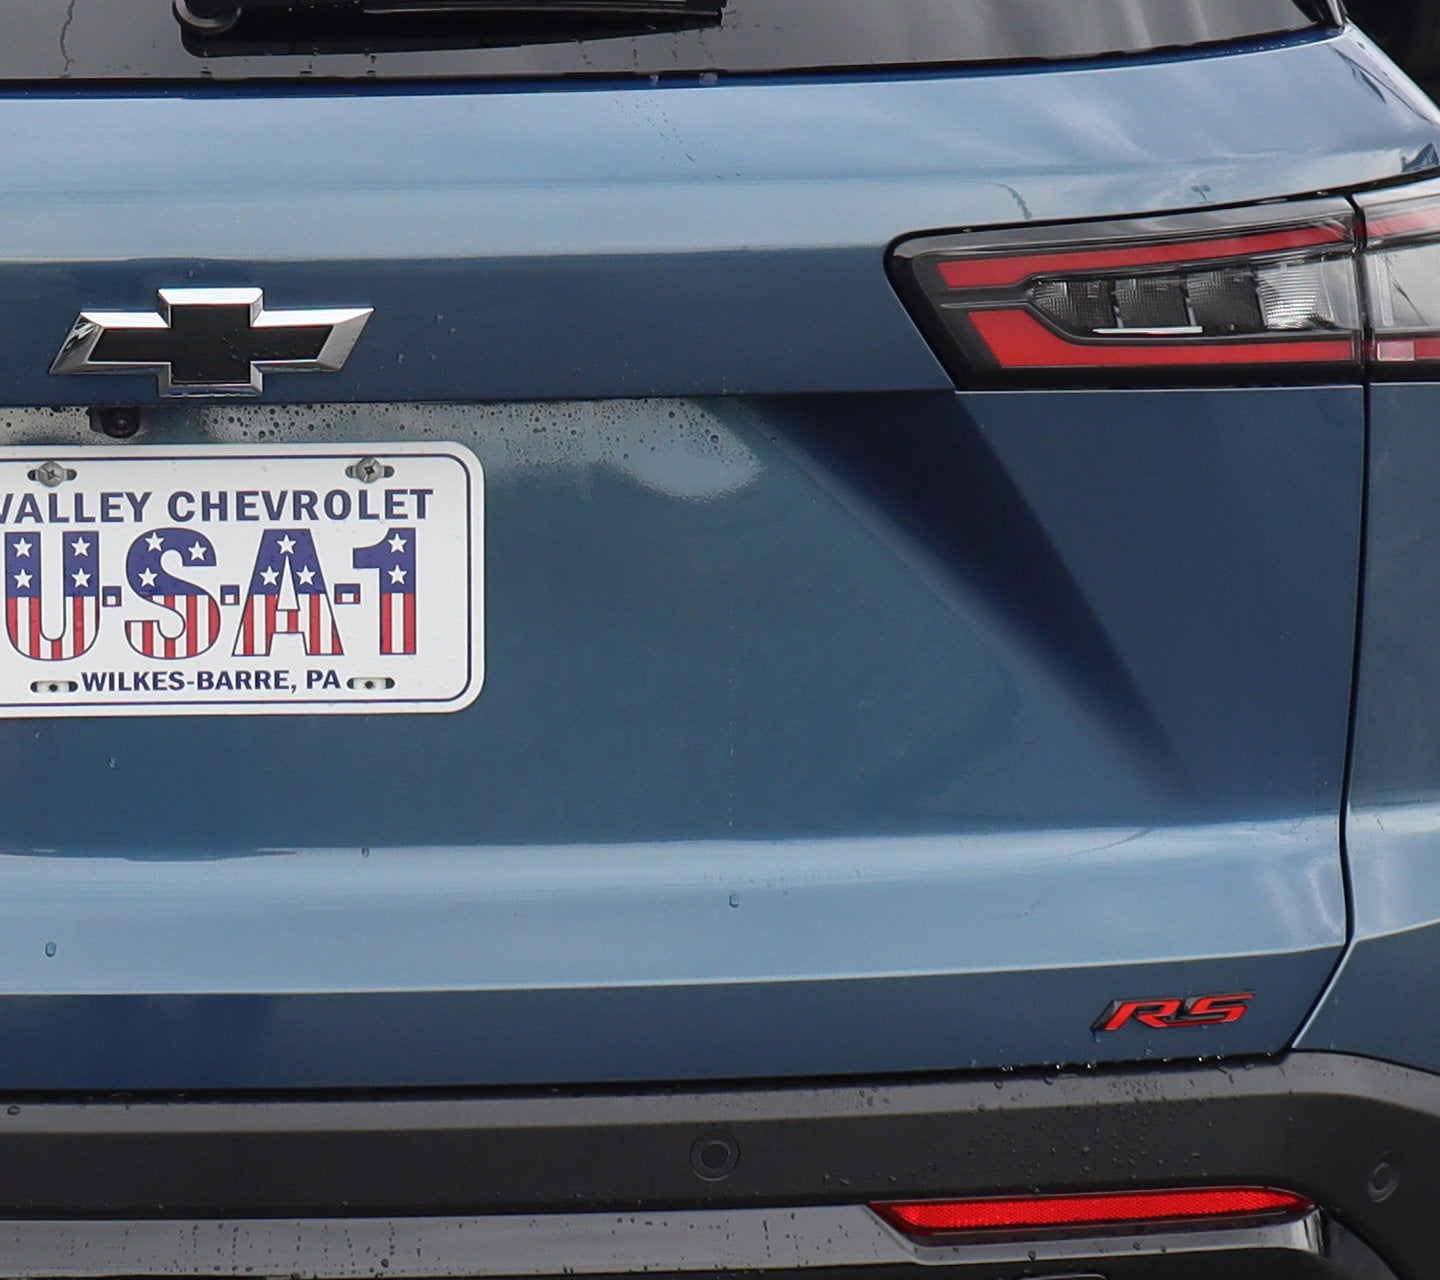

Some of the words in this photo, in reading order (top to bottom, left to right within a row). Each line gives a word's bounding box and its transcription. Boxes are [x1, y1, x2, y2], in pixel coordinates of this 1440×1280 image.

[166, 488, 434, 521] CHEVROLET
[81, 669, 298, 693] WILKES-BARRE,
[306, 669, 342, 691] PA
[1090, 988, 1256, 1033] RS
